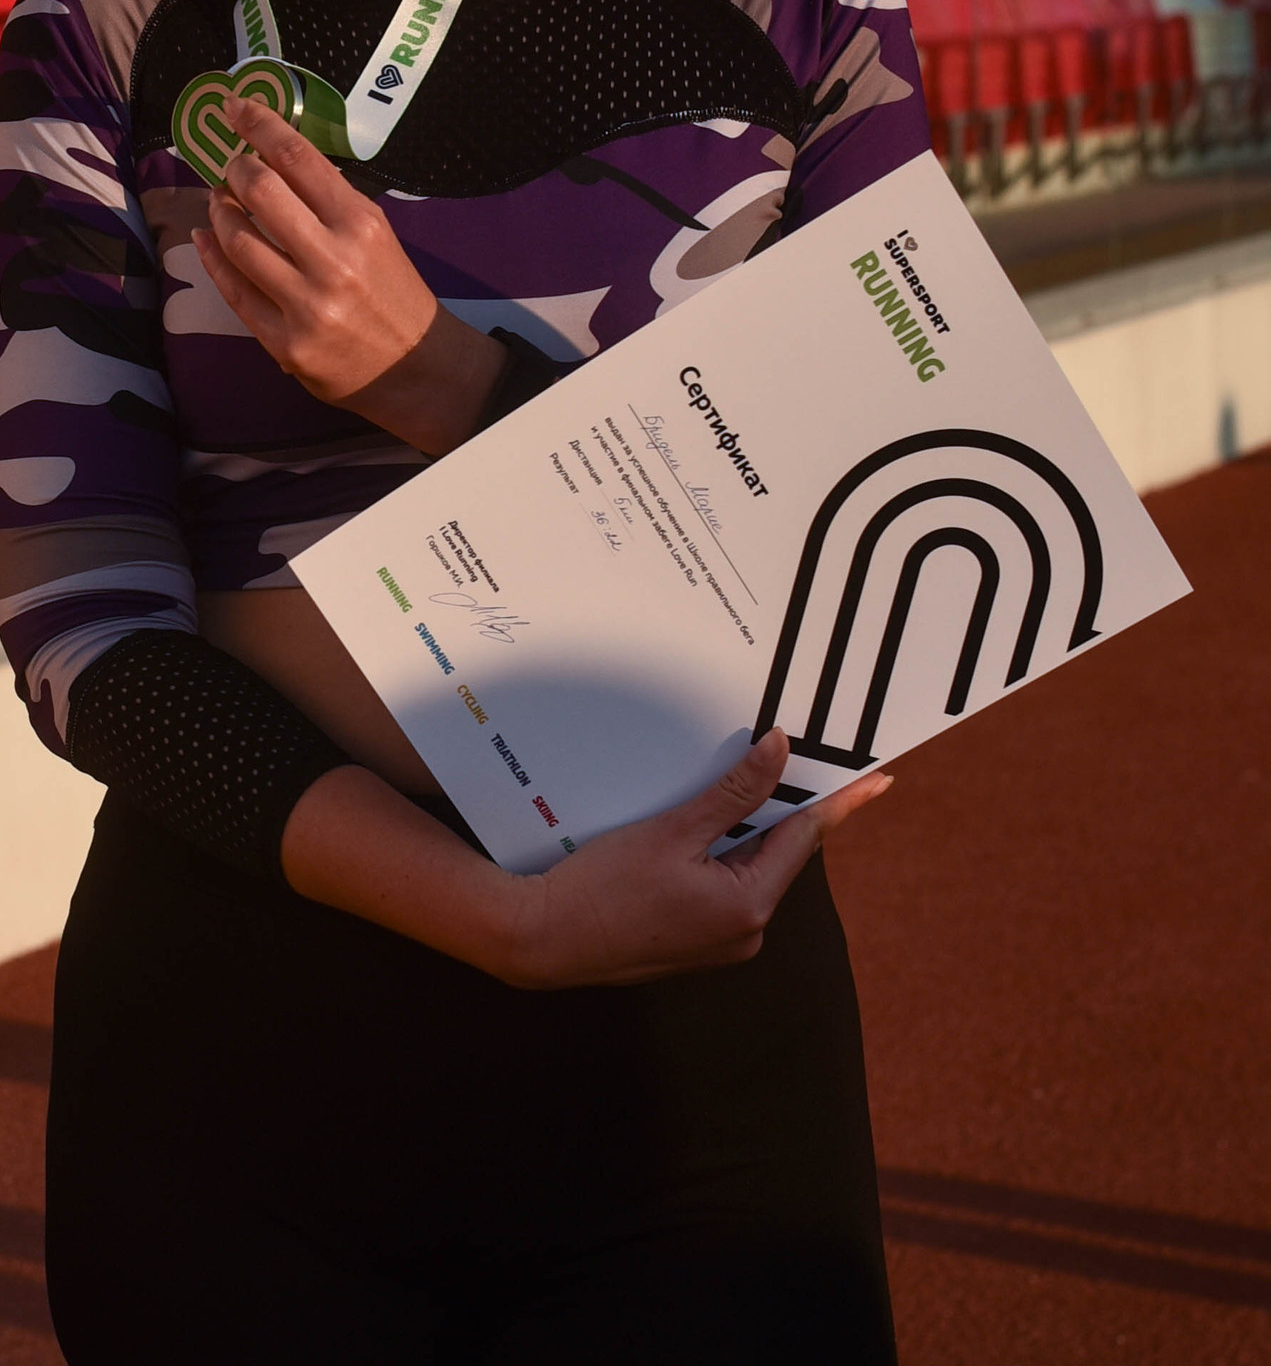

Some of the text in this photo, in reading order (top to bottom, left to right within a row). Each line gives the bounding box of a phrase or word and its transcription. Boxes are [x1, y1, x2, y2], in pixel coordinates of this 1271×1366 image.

[367, 89, 393, 105] I
[896, 229, 909, 239] I
[849, 250, 946, 383] RUNNING
[883, 237, 951, 334] SUPERSPORT
[568, 439, 603, 486] Дистанция
[679, 366, 769, 497] Сертификат
[549, 452, 580, 494] Результат
[590, 426, 698, 587] и участие в финальном забеге Love Run
[425, 534, 452, 571] Горшков
[441, 529, 457, 551] Love
[454, 548, 479, 583] Running
[447, 520, 500, 594] Директор филиала
[604, 416, 755, 646] выдан за успешное обучение в Школе правильного бега
[376, 566, 413, 614] RUNNING
[414, 622, 456, 676] SWIMMING
[456, 684, 490, 725] CYCLING
[490, 733, 532, 788] TRIATHLON
[531, 795, 560, 828] SKIING
